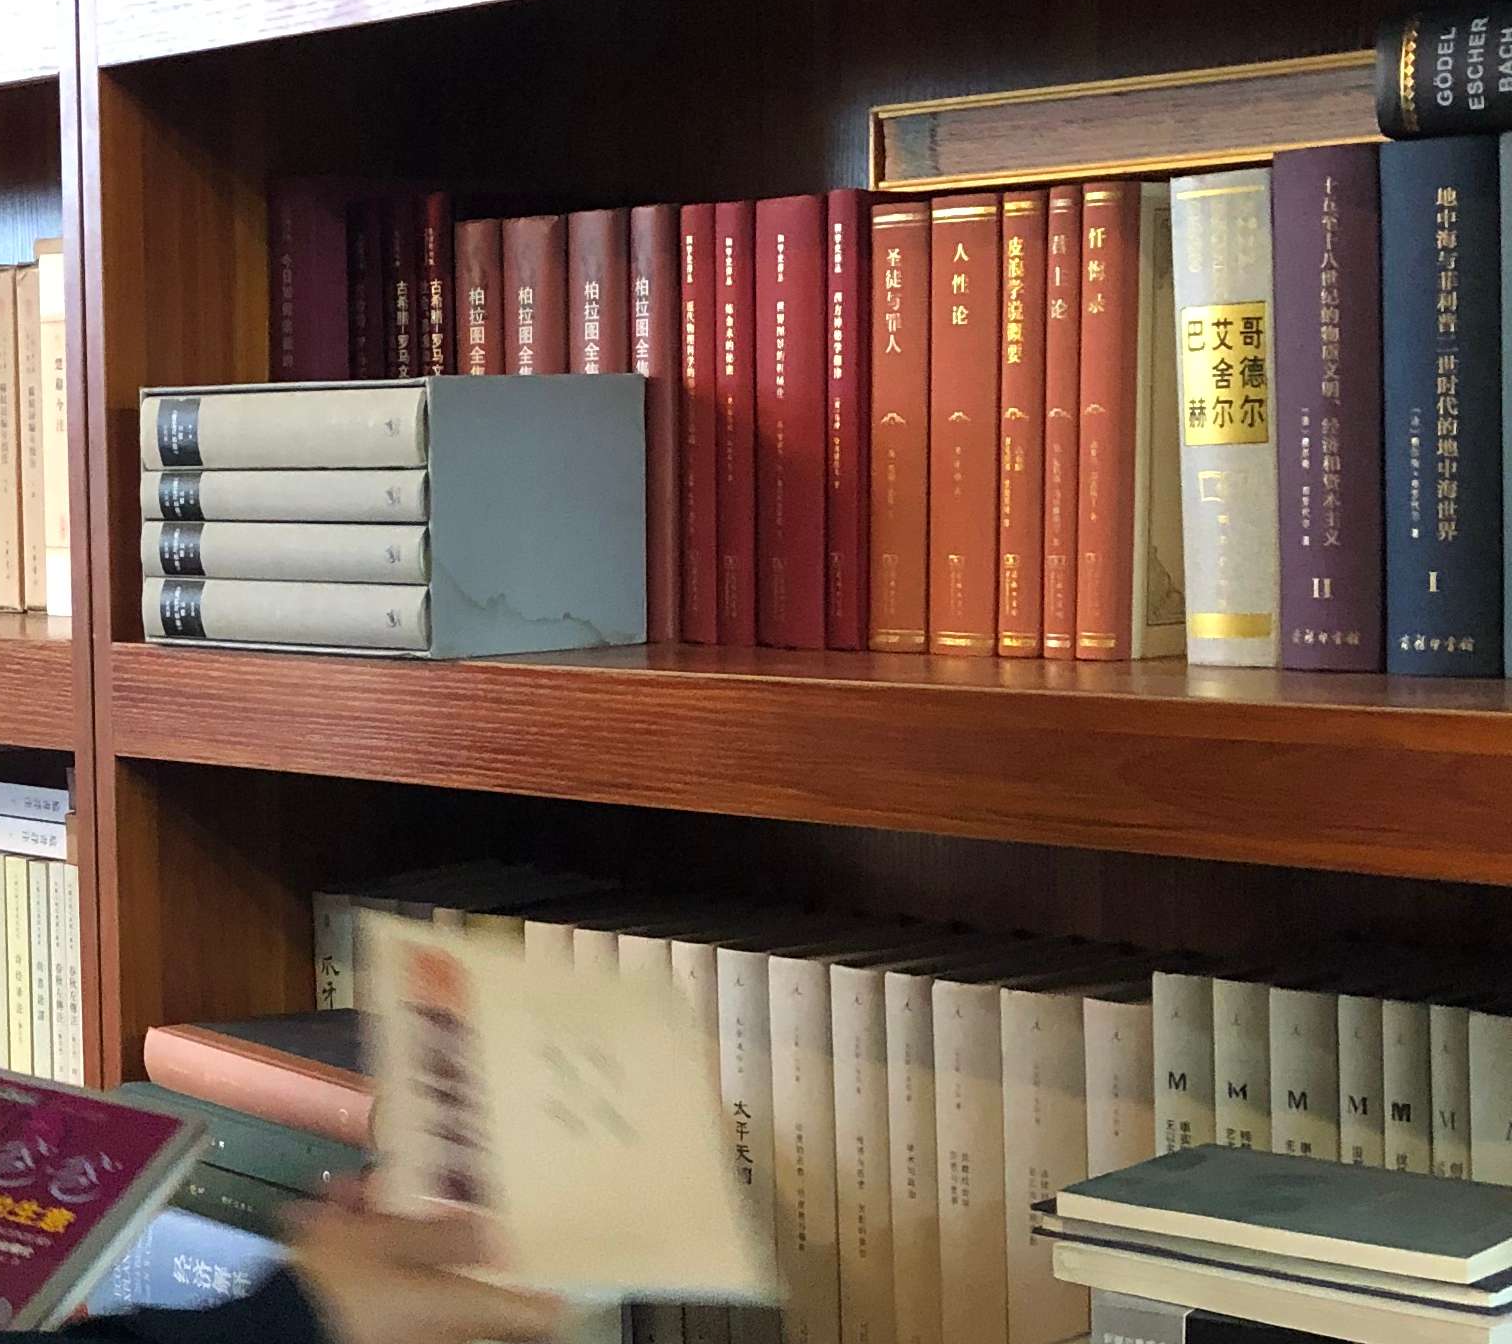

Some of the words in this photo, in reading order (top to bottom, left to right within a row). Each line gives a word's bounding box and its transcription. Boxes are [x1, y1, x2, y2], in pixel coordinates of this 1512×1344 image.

[1436, 27, 1456, 106] GÖDEL
[1467, 16, 1489, 110] ESCHER
[1498, 26, 1512, 93] BACH
[886, 248, 903, 355] 圣徒与罪人
[952, 243, 969, 325] 人性论
[1007, 237, 1025, 364] 皮浪学说概要
[1088, 227, 1106, 315] 忏悔录
[1188, 320, 1207, 429] 巴赫
[1211, 319, 1234, 429] 艾舍尔
[1239, 316, 1267, 429] 哥德尔
[1435, 187, 1459, 542] 地中海与菲利普二世时代的地中海世界
[1311, 578, 1332, 598] II
[1400, 633, 1476, 652] 商务印书馆
[319, 955, 339, 1009] 爪牙
[1168, 1070, 1188, 1092] M
[1227, 1080, 1249, 1102] M
[1287, 1090, 1309, 1112] M
[1347, 1094, 1369, 1117] M
[1391, 1102, 1412, 1123] M
[1439, 1109, 1457, 1132] M
